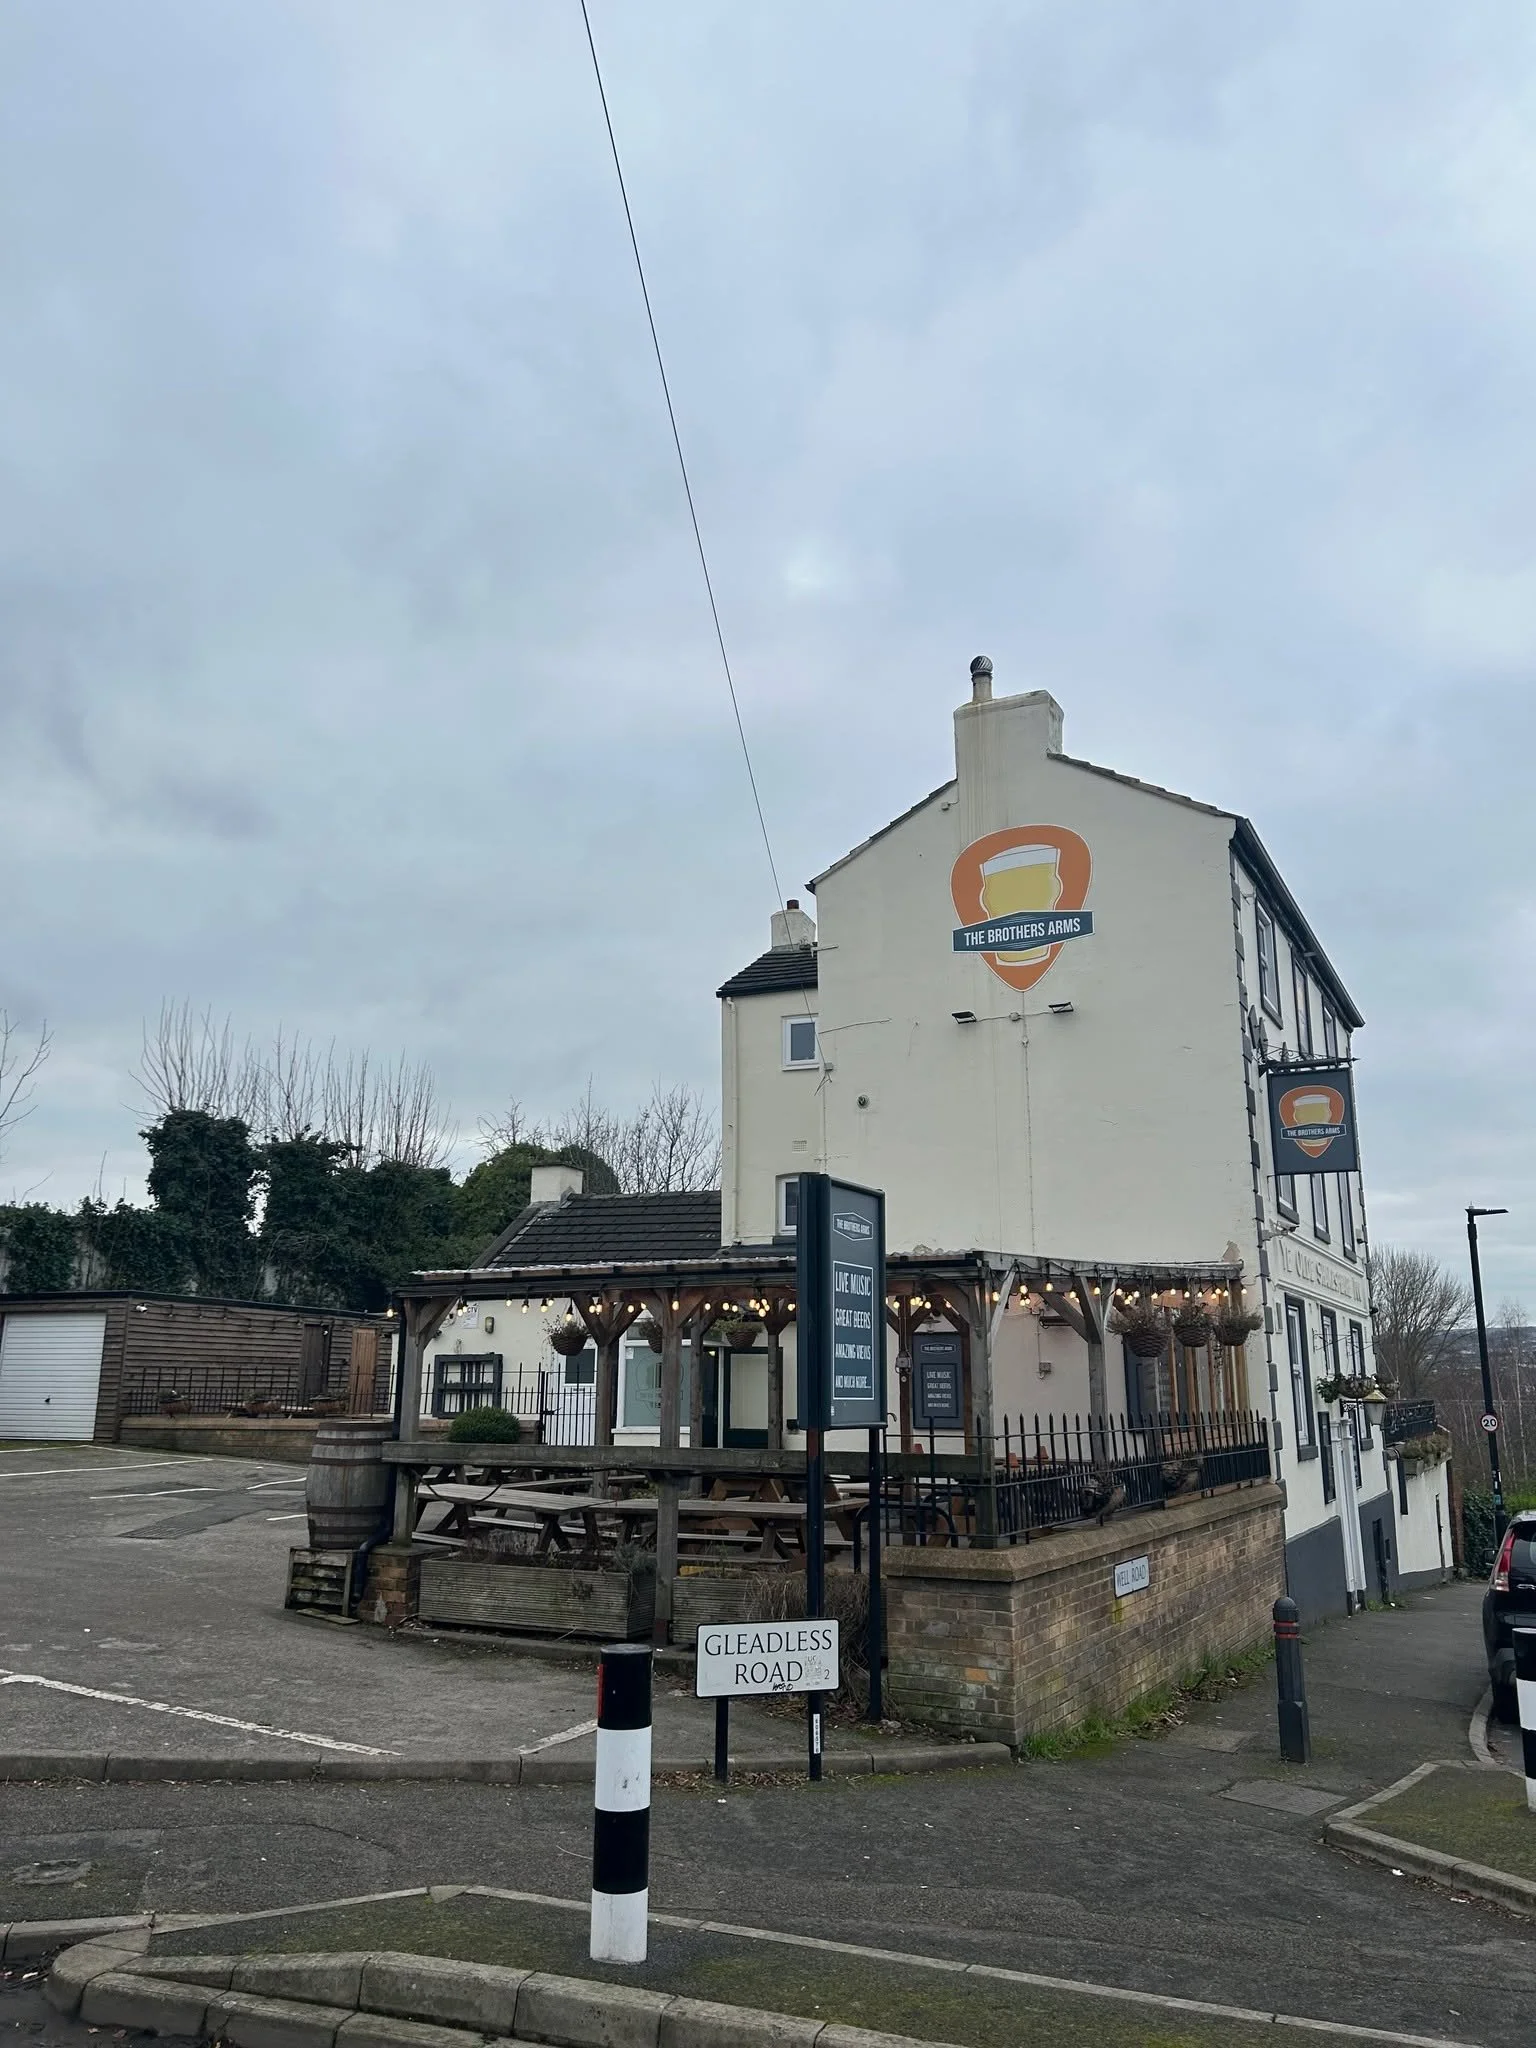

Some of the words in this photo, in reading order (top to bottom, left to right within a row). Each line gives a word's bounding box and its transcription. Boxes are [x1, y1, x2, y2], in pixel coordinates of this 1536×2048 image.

[964, 931, 985, 946] THE
[987, 923, 1045, 944] BROTHERS
[1048, 917, 1081, 935] ARMS
[1298, 1128, 1325, 1136] BROTHERS
[1325, 1127, 1340, 1135] ARMS
[835, 1271, 849, 1294] LIVE
[850, 1273, 871, 1297] MUSIC
[835, 1307, 853, 1328] GREAT
[854, 1310, 871, 1329] BEERS
[835, 1343, 856, 1360] AMAZING
[857, 1345, 871, 1361] VIEWS
[835, 1375, 844, 1388] AND
[844, 1375, 855, 1389] MUCH
[1483, 1418, 1497, 1428] 20
[1116, 1570, 1130, 1588] WELL
[1131, 1564, 1146, 1583] ROAD
[704, 1629, 832, 1656] GLEADLESS
[735, 1661, 803, 1685] ROAD
